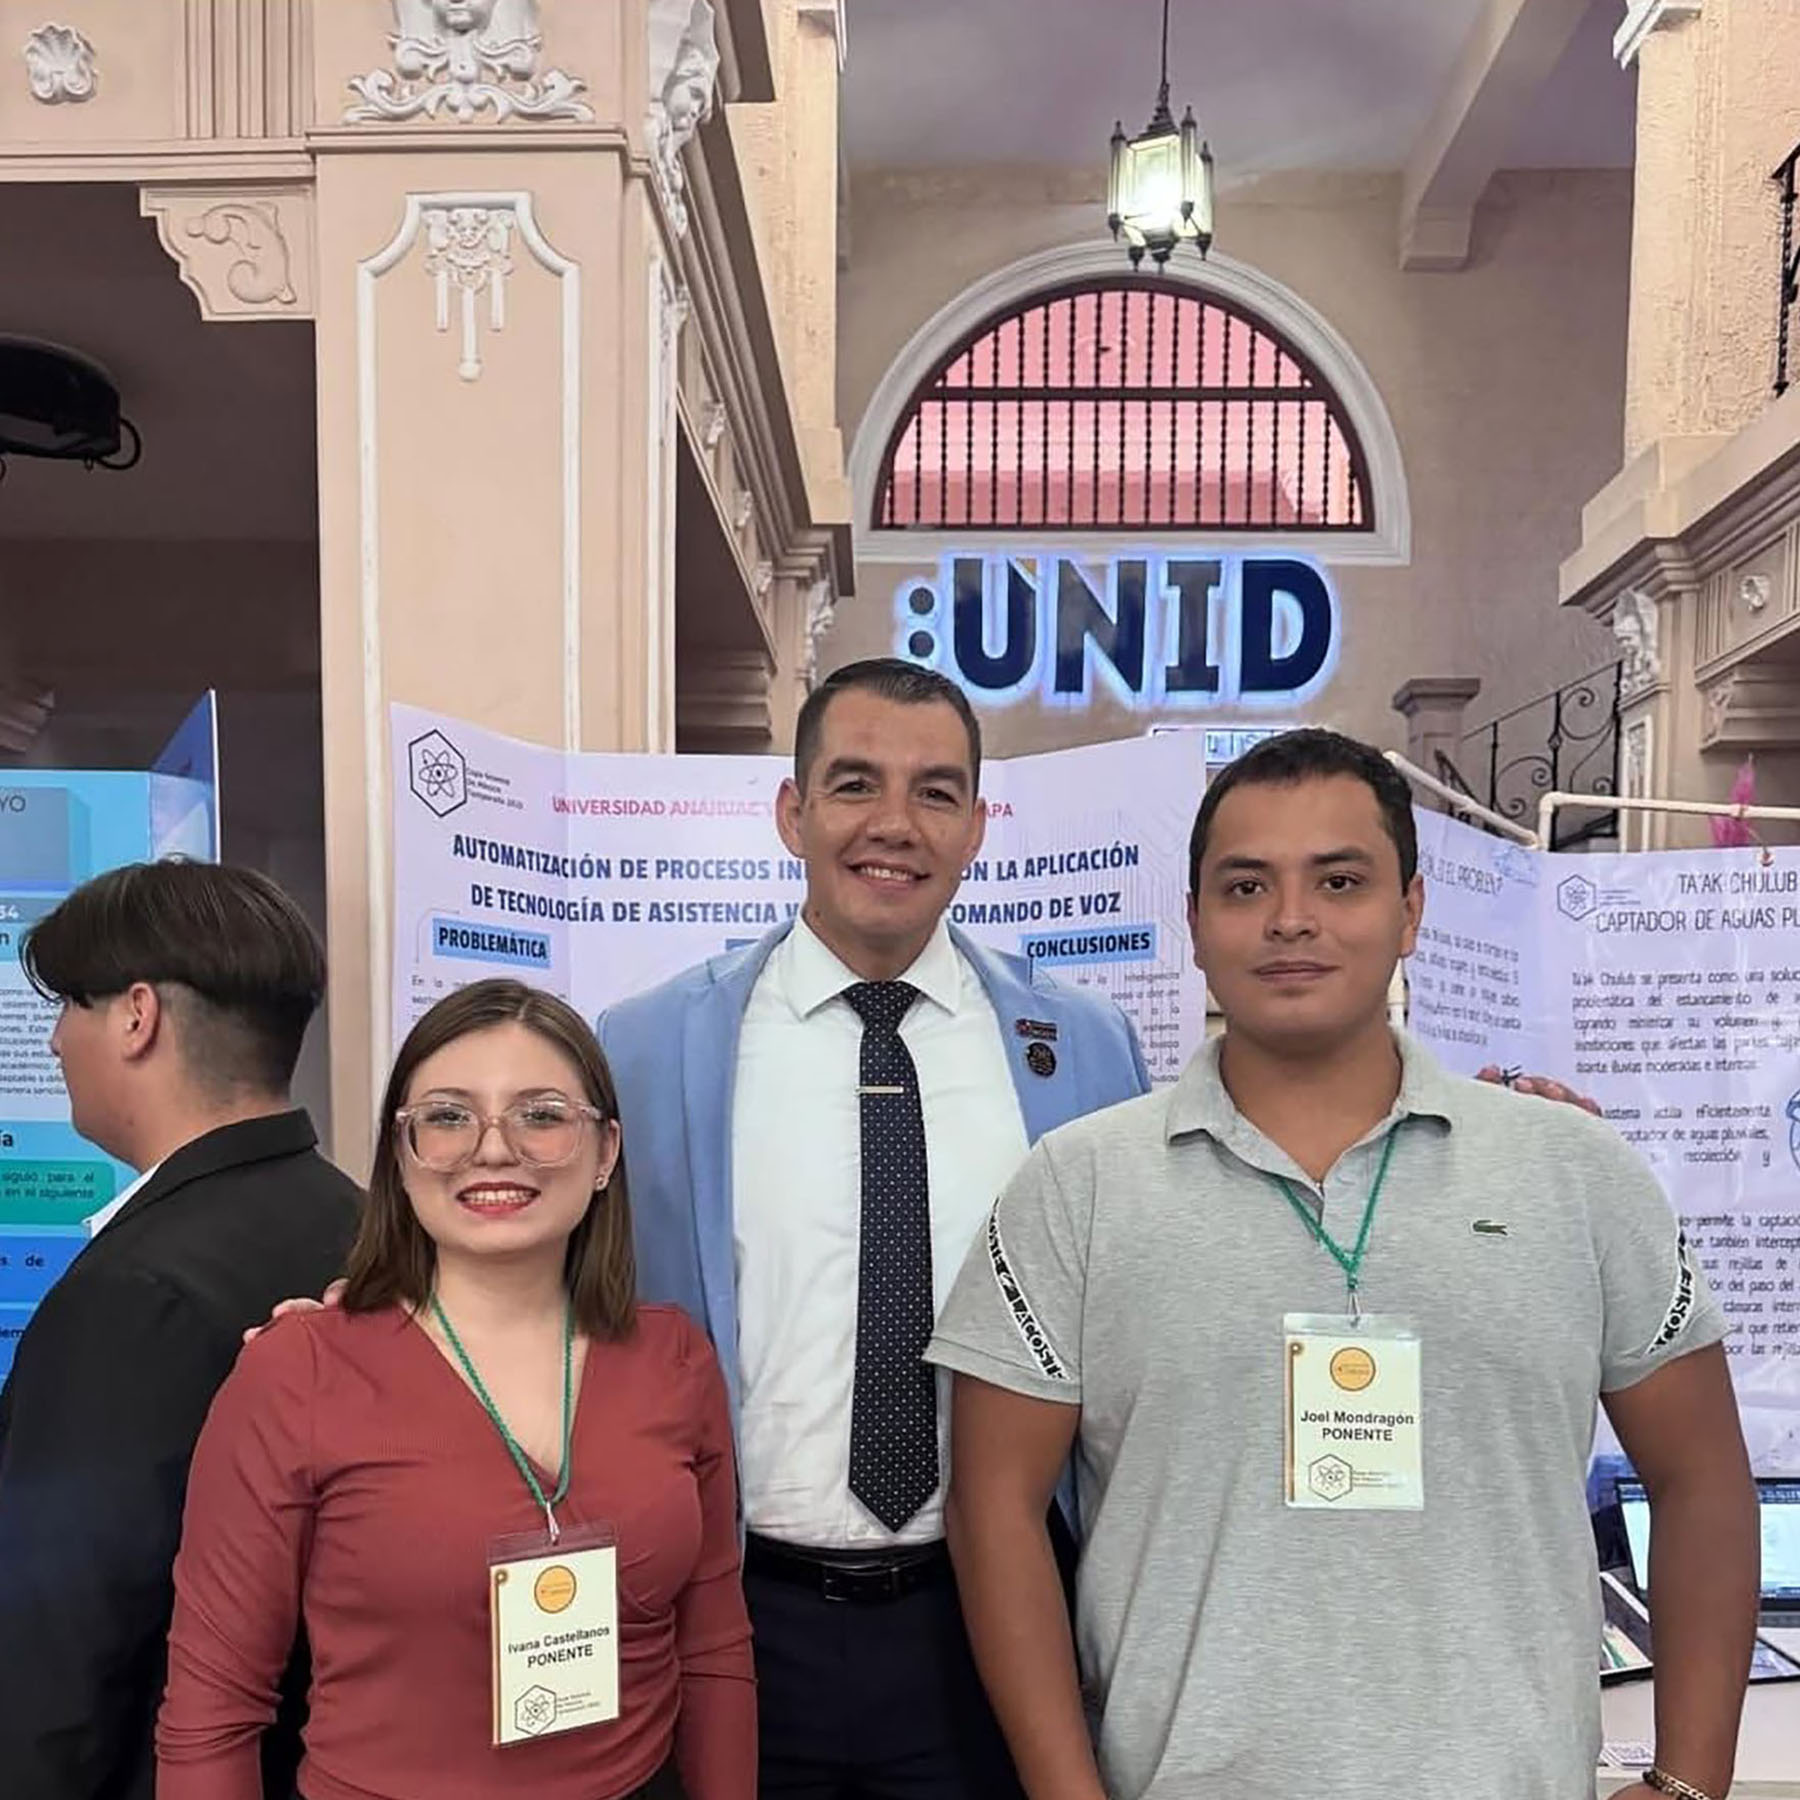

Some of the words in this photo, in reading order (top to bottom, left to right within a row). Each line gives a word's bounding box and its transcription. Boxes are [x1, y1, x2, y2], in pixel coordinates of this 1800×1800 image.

[552, 797, 665, 816] UNIVERSIDAD
[453, 834, 612, 879] AUTOMATIZACIÓN
[620, 859, 648, 879] DE
[655, 859, 770, 880] PROCESOS
[997, 860, 1018, 881] LA
[1024, 841, 1139, 878] APLICACIÓN
[1730, 870, 1798, 894] CHULUB
[471, 884, 493, 908] DE
[497, 888, 604, 922] TECNOLOGÍA
[612, 902, 641, 922] DE
[648, 902, 778, 923] ASISTENCIA
[1049, 897, 1074, 918] DE
[1080, 892, 1121, 915] VOZ
[1596, 909, 1686, 933] CAPTADOR
[1695, 908, 1715, 930] DE
[1721, 907, 1775, 930] AGUAS
[438, 926, 548, 959] PROBLEMÁTICA
[1027, 932, 1151, 958] CONCLUSIONES
[1708, 972, 1739, 984] como
[25, 1254, 45, 1268] de
[1301, 1410, 1330, 1424] Joel
[1334, 1410, 1414, 1427] Mondragón
[1322, 1428, 1393, 1441] PONENTE
[507, 1639, 541, 1655] Ivana
[543, 1624, 610, 1648] Castellanos
[527, 1644, 593, 1668] PONENTE
